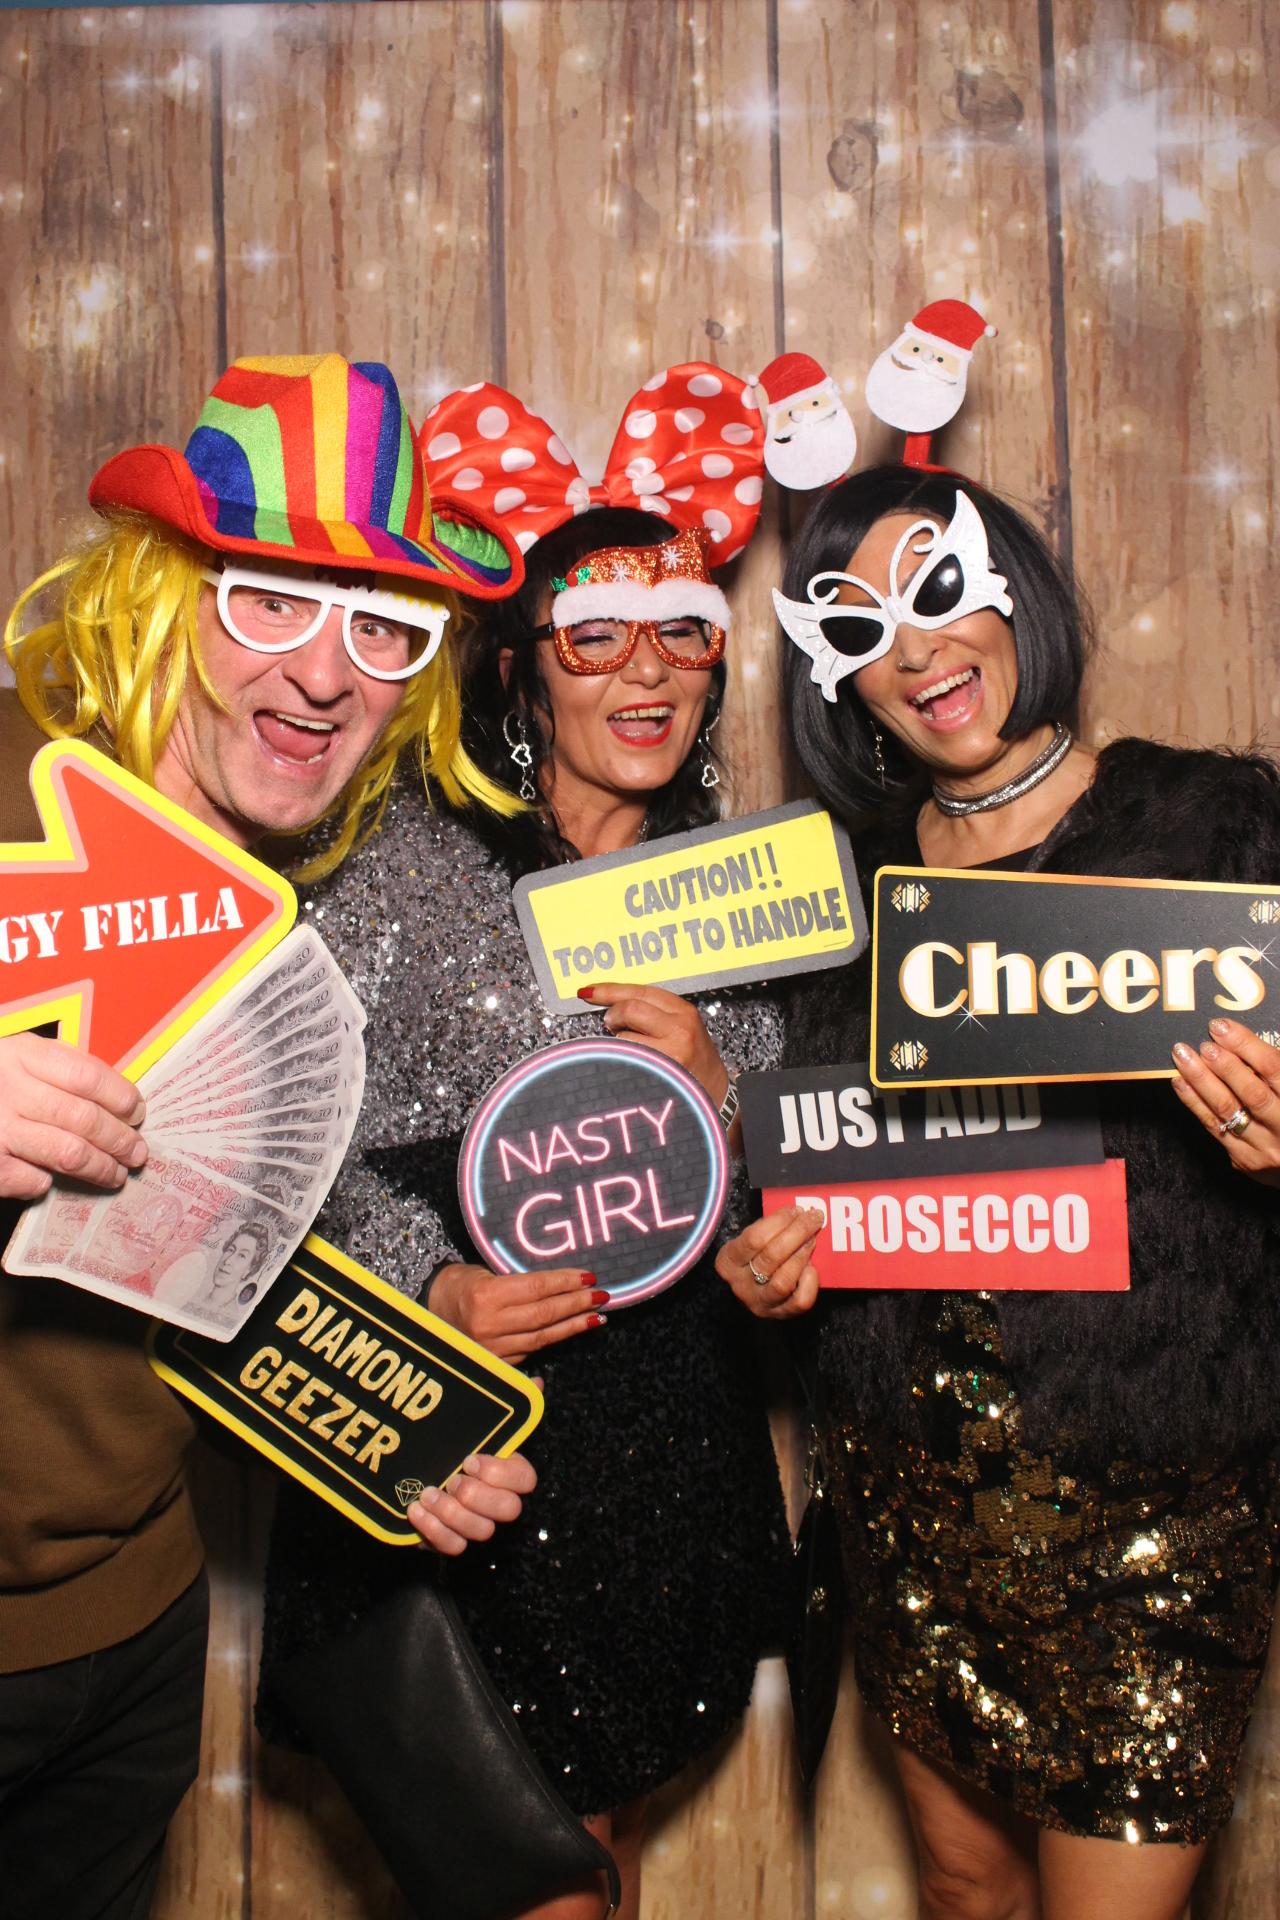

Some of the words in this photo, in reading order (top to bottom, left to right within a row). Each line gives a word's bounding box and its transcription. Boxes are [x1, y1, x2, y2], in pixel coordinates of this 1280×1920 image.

[80, 887, 244, 951] FELLA
[624, 842, 783, 918] CAUTION!!
[553, 942, 616, 978] TOO
[618, 924, 679, 968] HOT
[683, 917, 726, 955] TO
[728, 887, 848, 949] HANDLE
[898, 941, 1265, 1018] Cheers
[497, 1098, 674, 1183] NASTY
[778, 1086, 906, 1155] JUST
[924, 1085, 1043, 1141] ADD
[514, 1167, 696, 1257] GIRL
[275, 1287, 444, 1422] DIAMOND
[239, 1345, 401, 1474] GEEZER
